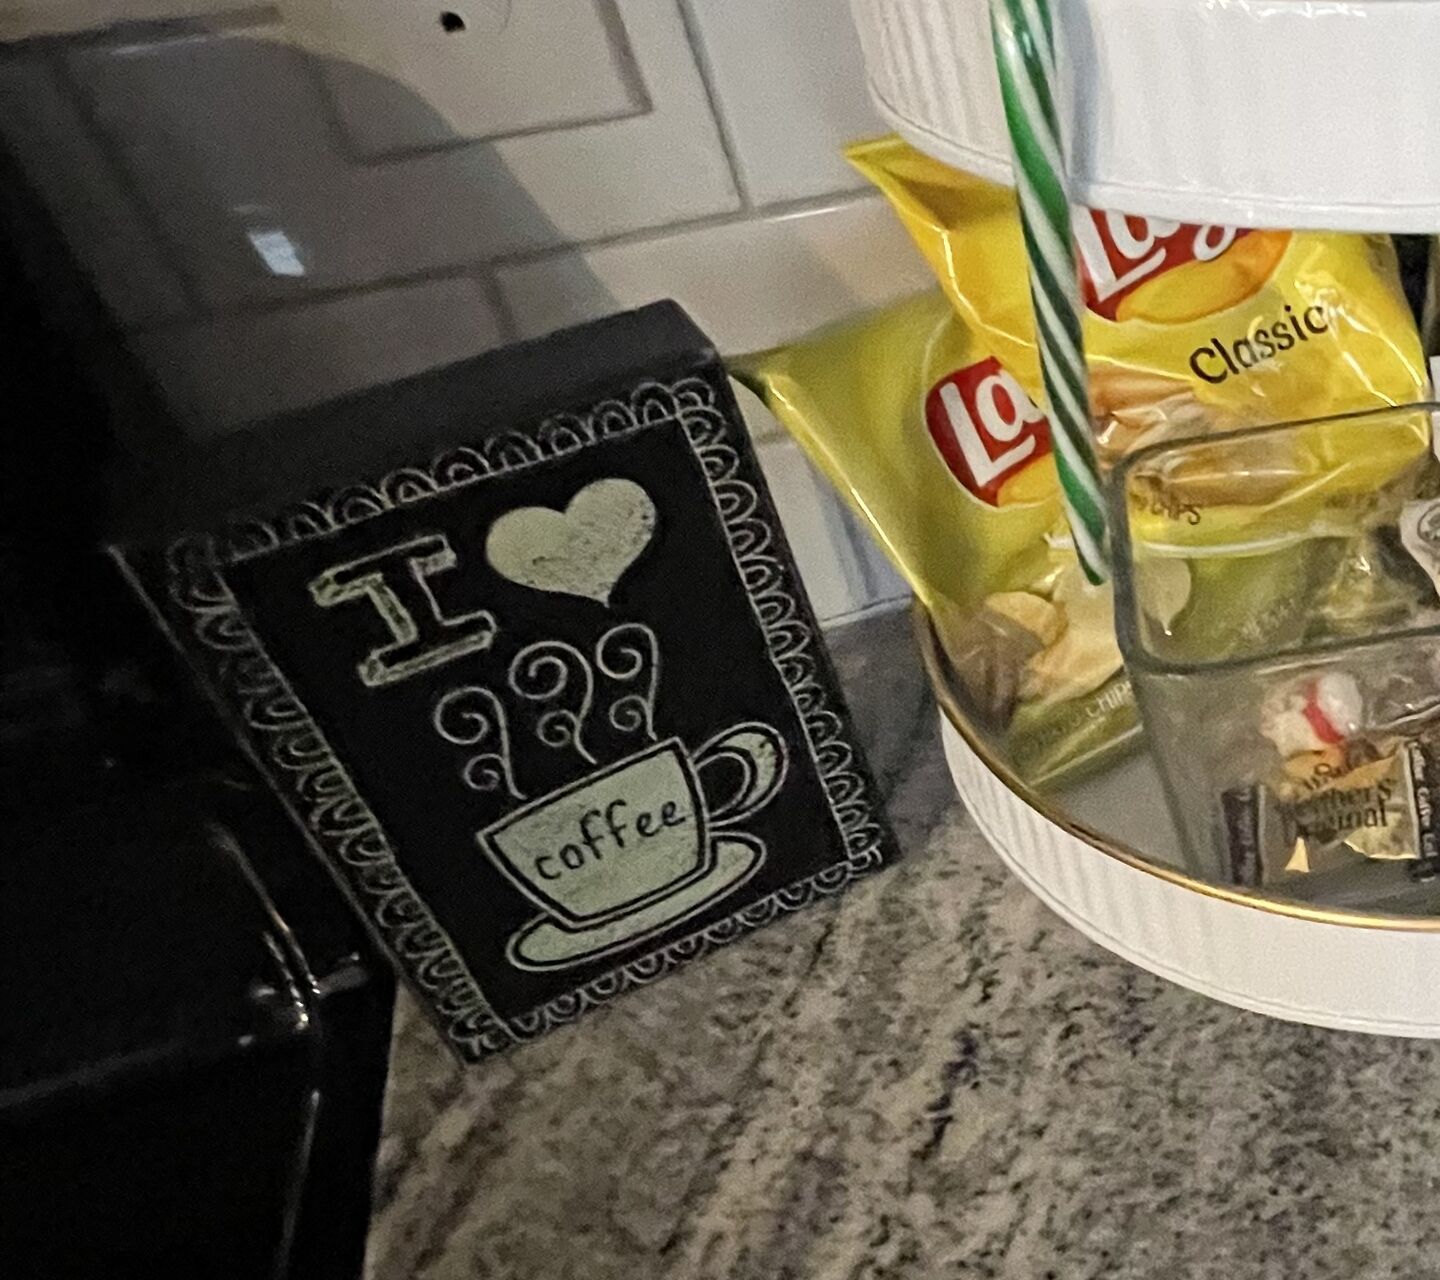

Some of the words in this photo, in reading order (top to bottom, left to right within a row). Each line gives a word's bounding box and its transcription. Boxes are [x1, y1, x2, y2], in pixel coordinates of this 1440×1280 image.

[1189, 304, 1329, 385] Classic
[308, 533, 498, 688] I
[533, 795, 687, 882] coffee
